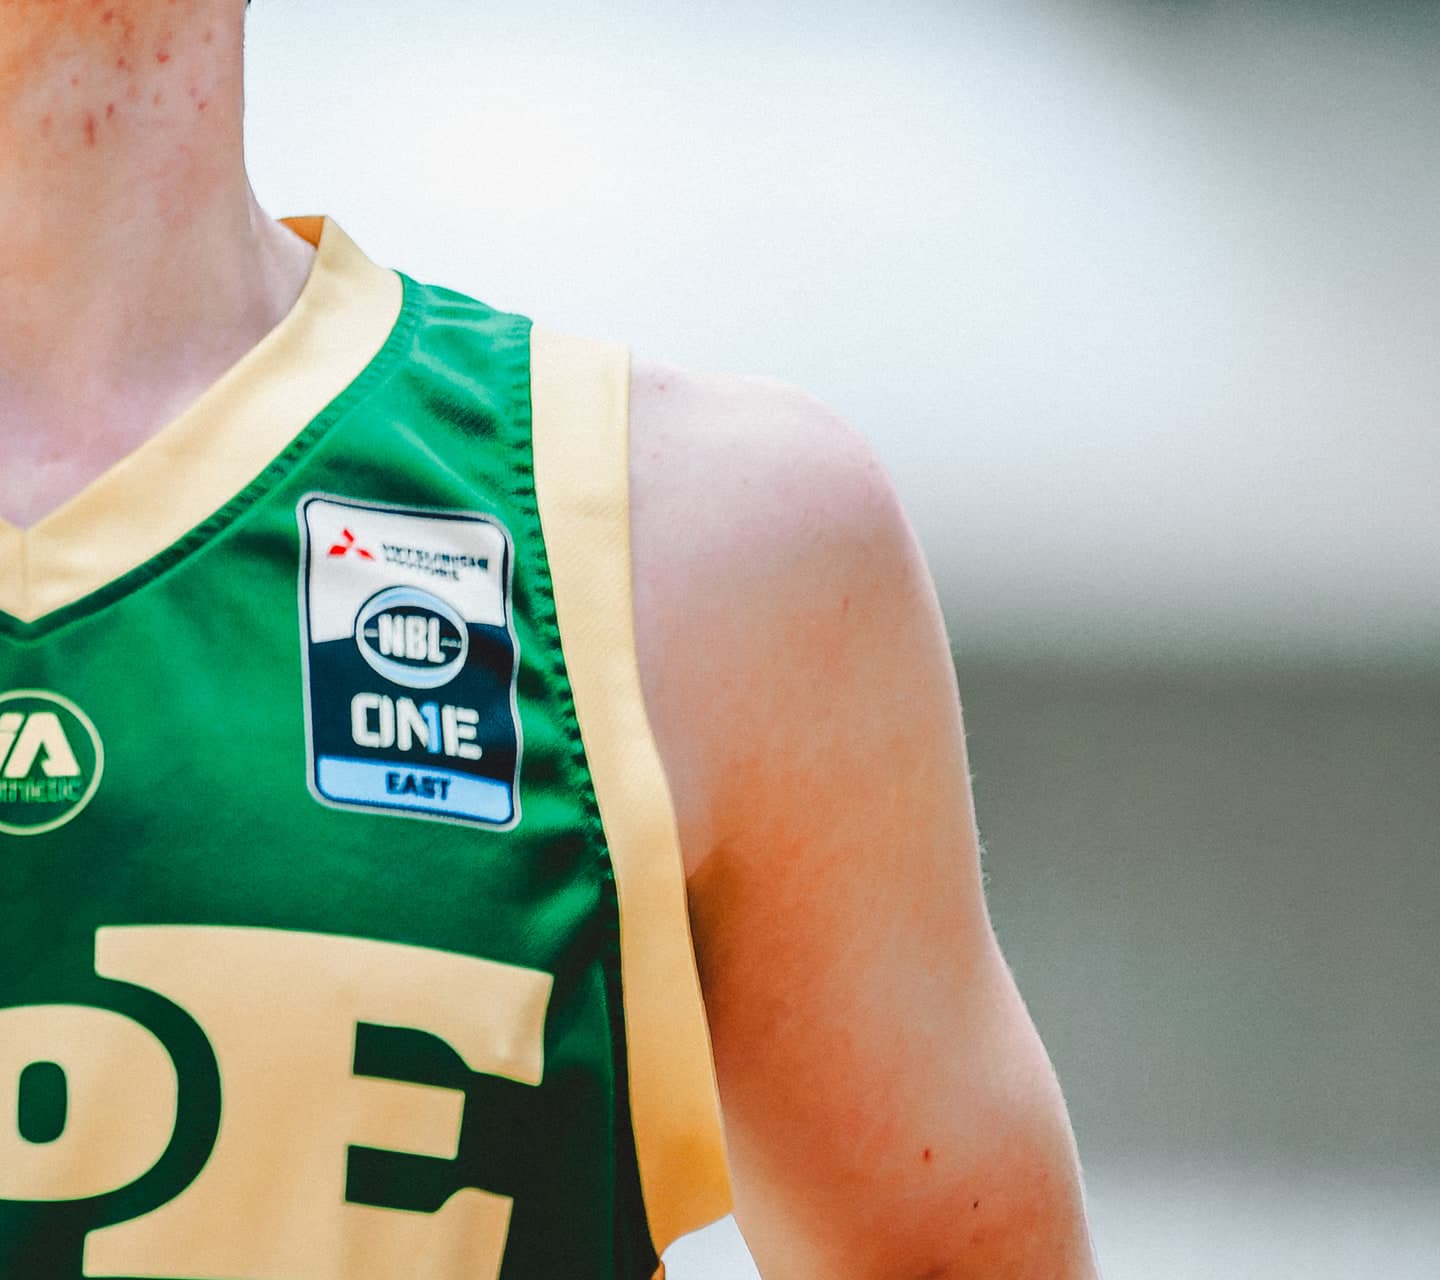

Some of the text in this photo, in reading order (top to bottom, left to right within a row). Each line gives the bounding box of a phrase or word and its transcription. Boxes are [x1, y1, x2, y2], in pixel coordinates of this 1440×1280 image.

[377, 613, 447, 664] NBL
[350, 692, 483, 761] ONE
[385, 770, 452, 801] EAST
